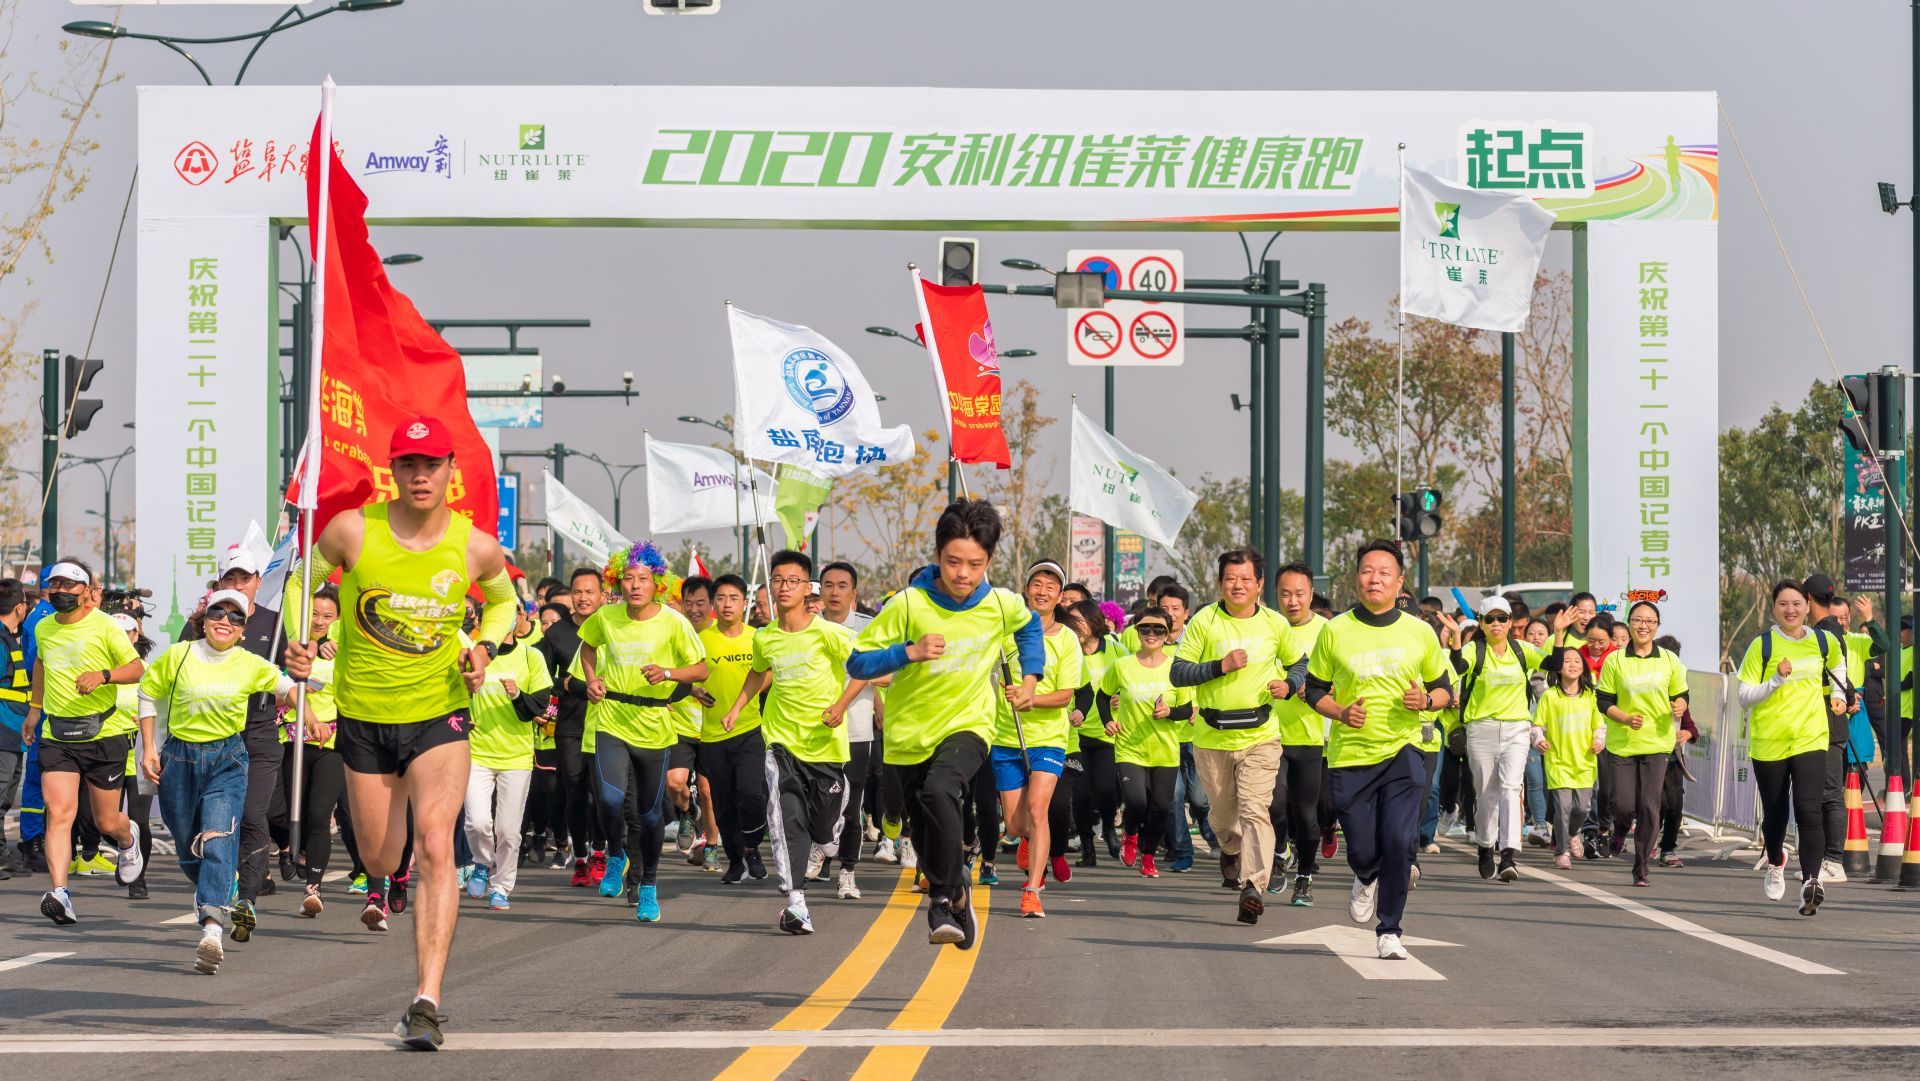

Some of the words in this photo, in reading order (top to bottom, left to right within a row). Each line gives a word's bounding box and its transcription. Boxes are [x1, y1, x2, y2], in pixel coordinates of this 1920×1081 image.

[224, 138, 345, 184] 盐阜大
[365, 152, 430, 173] Amway
[426, 134, 451, 179] 安利
[479, 154, 587, 166] NUTRILITE
[494, 169, 572, 181] 纽崔莱
[642, 129, 1364, 190] 2020安利纽崔莱健康跑
[1466, 129, 1585, 189] 起点
[1139, 269, 1167, 291] 40
[186, 257, 219, 577] 庆祝第二十一个中国记者节
[1638, 261, 1671, 579] 庆祝第二十一个中国记者节
